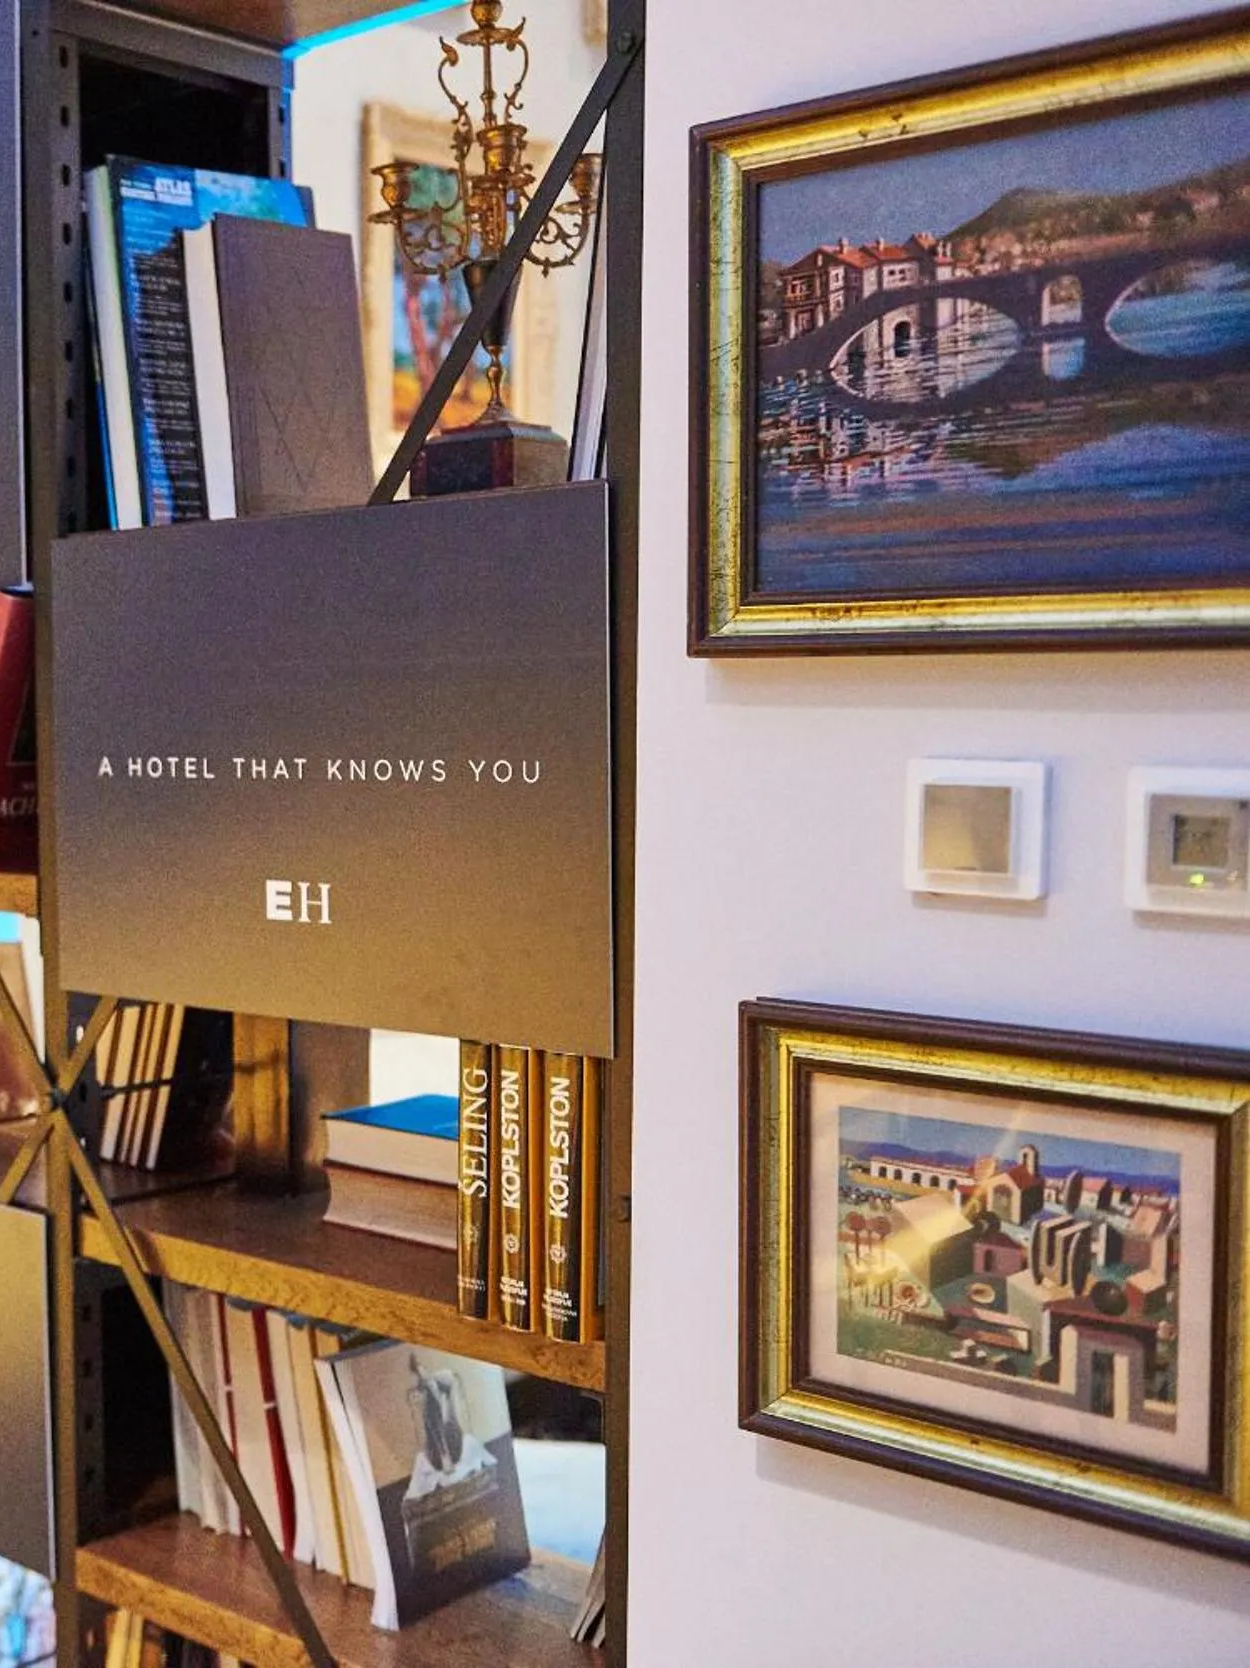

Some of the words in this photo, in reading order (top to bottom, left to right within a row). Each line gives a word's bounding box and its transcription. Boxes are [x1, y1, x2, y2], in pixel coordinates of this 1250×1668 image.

[97, 756, 114, 778] A
[128, 756, 216, 780] HOTEL
[233, 758, 308, 780] THAT
[327, 759, 447, 782] KNOWS
[468, 760, 542, 784] YOU
[265, 879, 333, 925] EH
[501, 1069, 521, 1210] KOPLSTON
[549, 1076, 571, 1219] KOPLSTON
